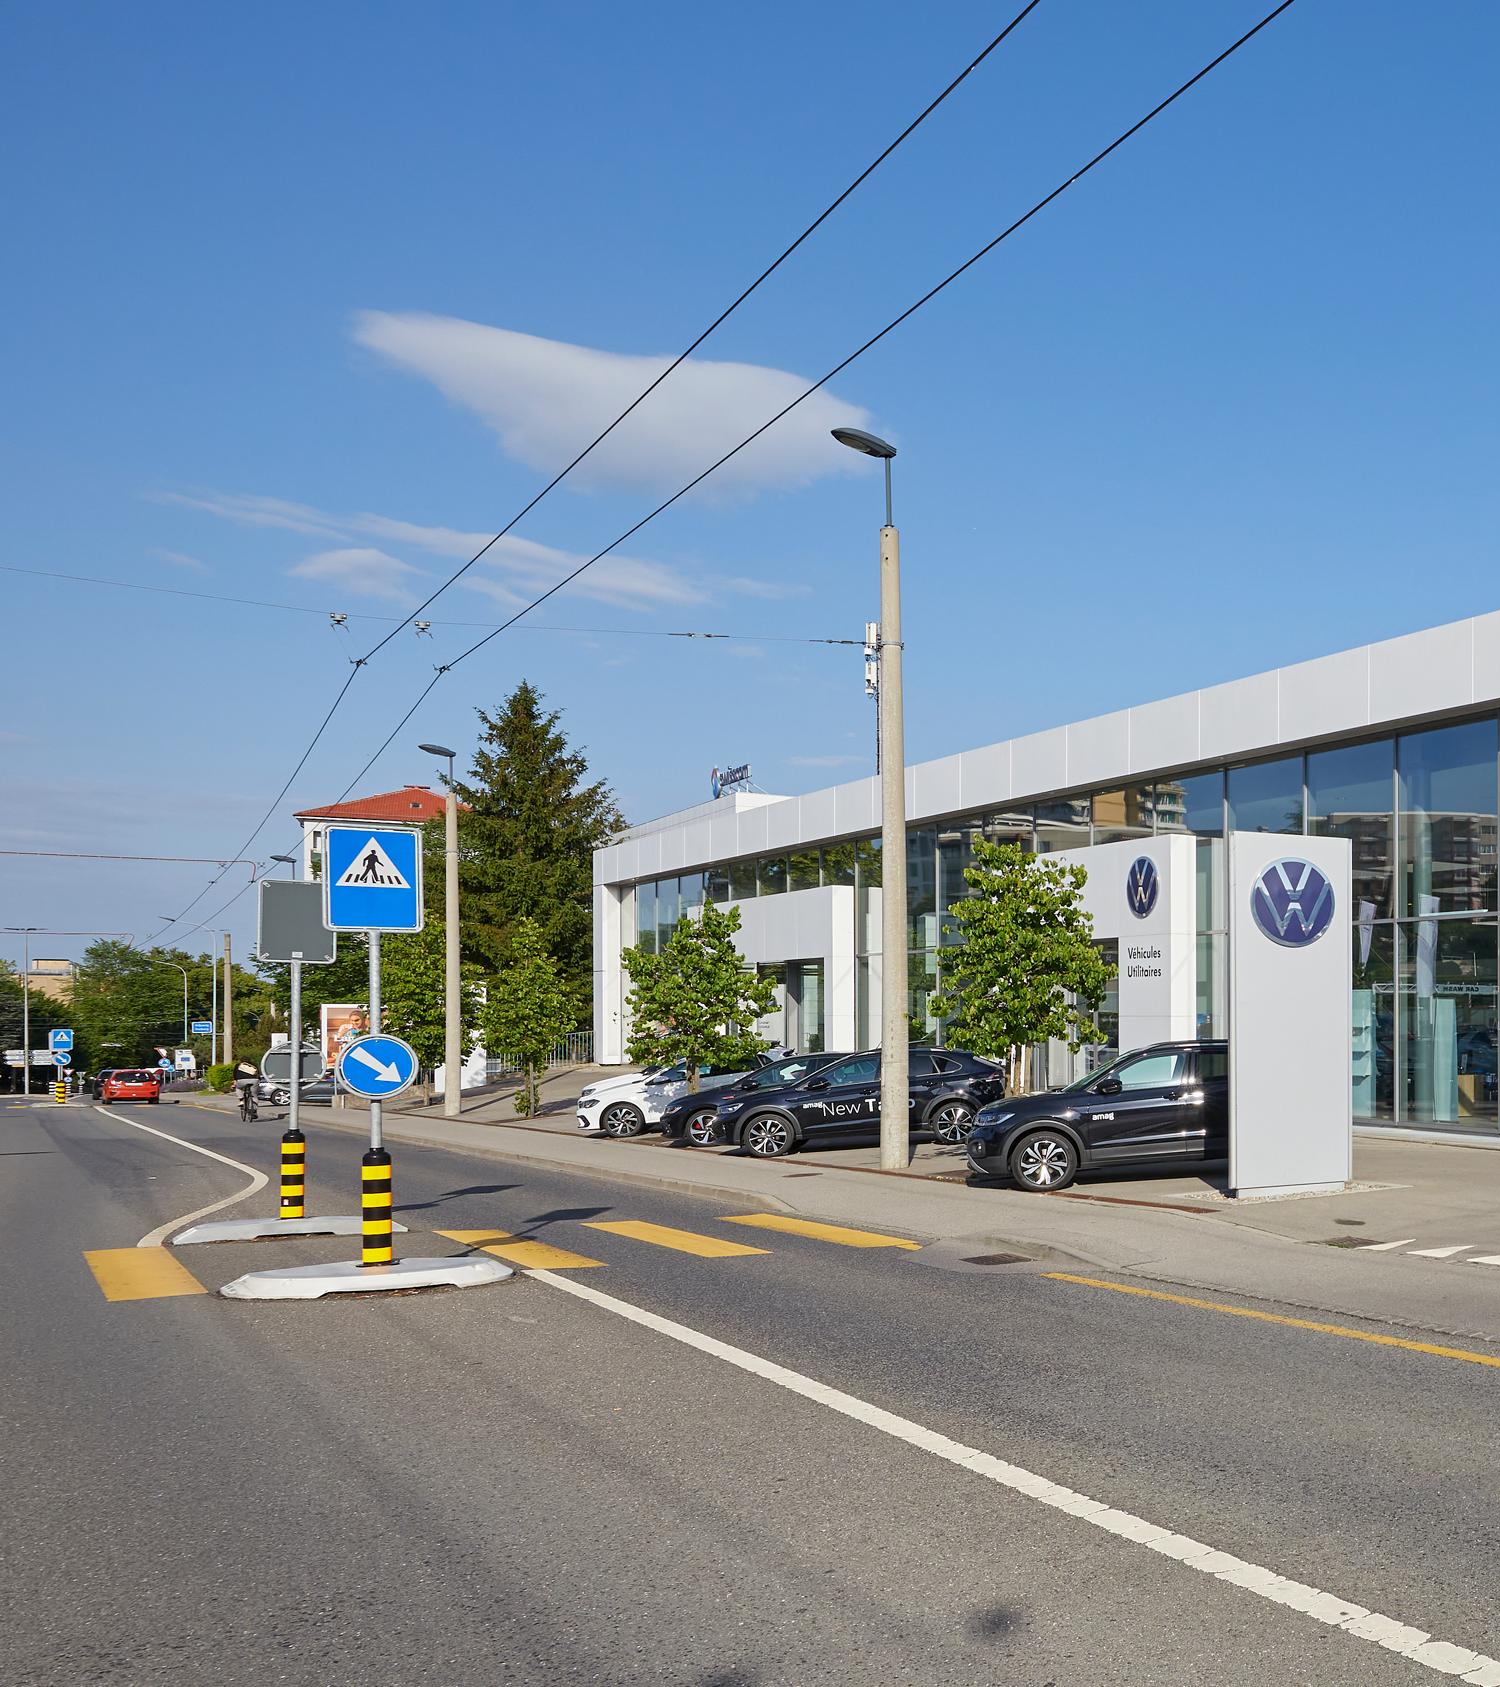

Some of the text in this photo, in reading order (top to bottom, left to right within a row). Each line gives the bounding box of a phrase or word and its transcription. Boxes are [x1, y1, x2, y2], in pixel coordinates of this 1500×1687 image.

[1127, 945, 1162, 959] Véhicules
[1127, 965, 1162, 978] Utilitaires
[803, 1101, 823, 1109] amag
[823, 1102, 860, 1117] New
[1092, 1112, 1115, 1121] amag
